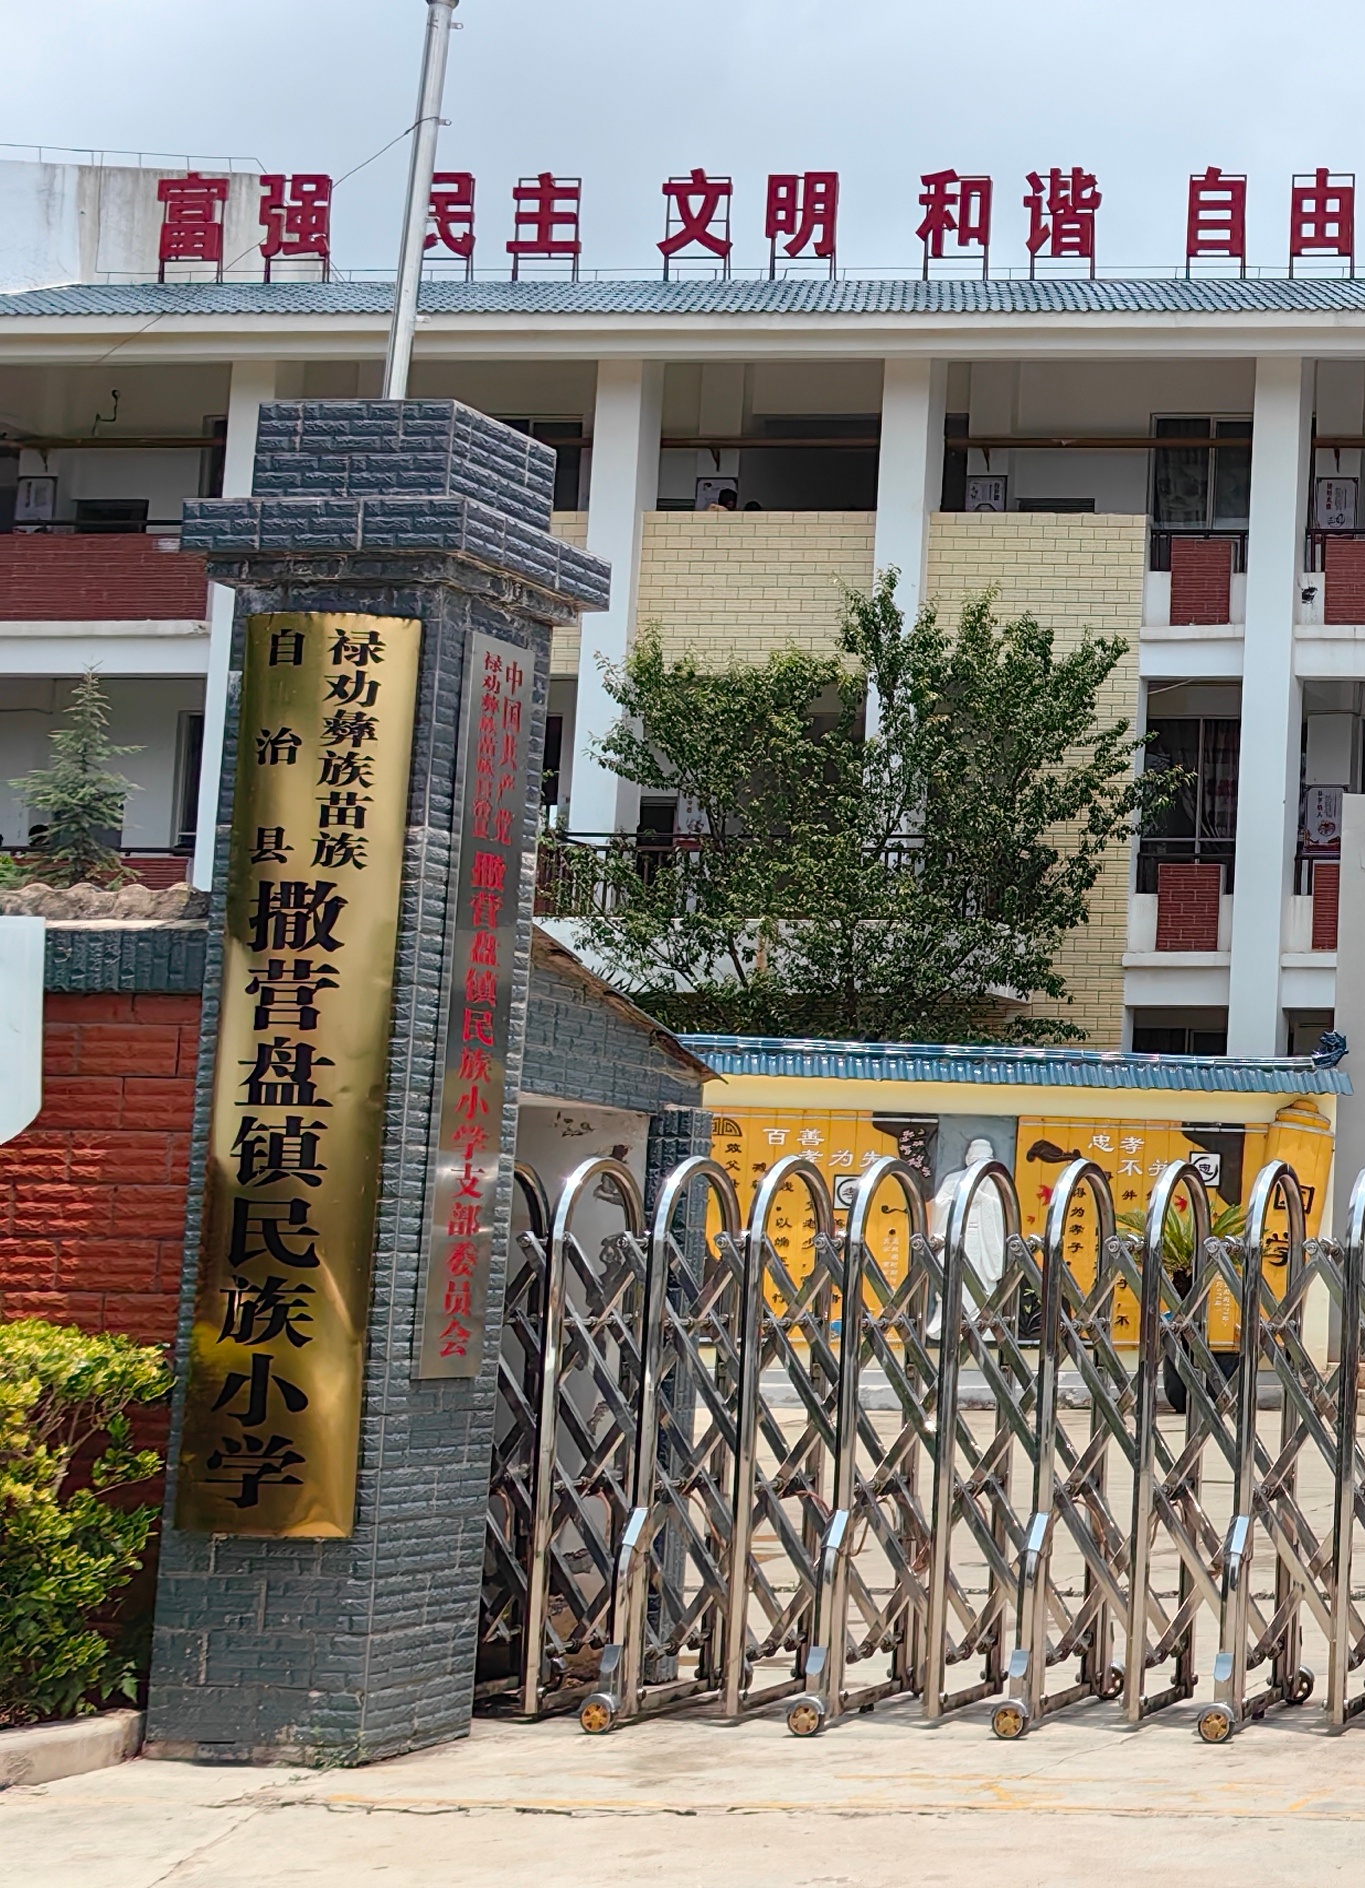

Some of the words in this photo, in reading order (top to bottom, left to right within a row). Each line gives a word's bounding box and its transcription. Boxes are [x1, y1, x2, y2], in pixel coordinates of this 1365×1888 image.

[157, 170, 333, 262] 富强
[424, 171, 583, 257] 民主
[655, 167, 840, 257] 文明
[915, 166, 1102, 258] 和谐
[1187, 166, 1356, 257] 自由
[247, 627, 306, 865] 自治县
[311, 627, 387, 870] 禄劝彝族苗族
[492, 659, 524, 846] 中国共产党
[203, 879, 350, 1510] 撒营盘镇民族小学
[438, 850, 508, 1358] 撒营盘镇民族小学支部委员会
[762, 1128, 825, 1147] 百善
[1088, 1134, 1146, 1154] 忠孝
